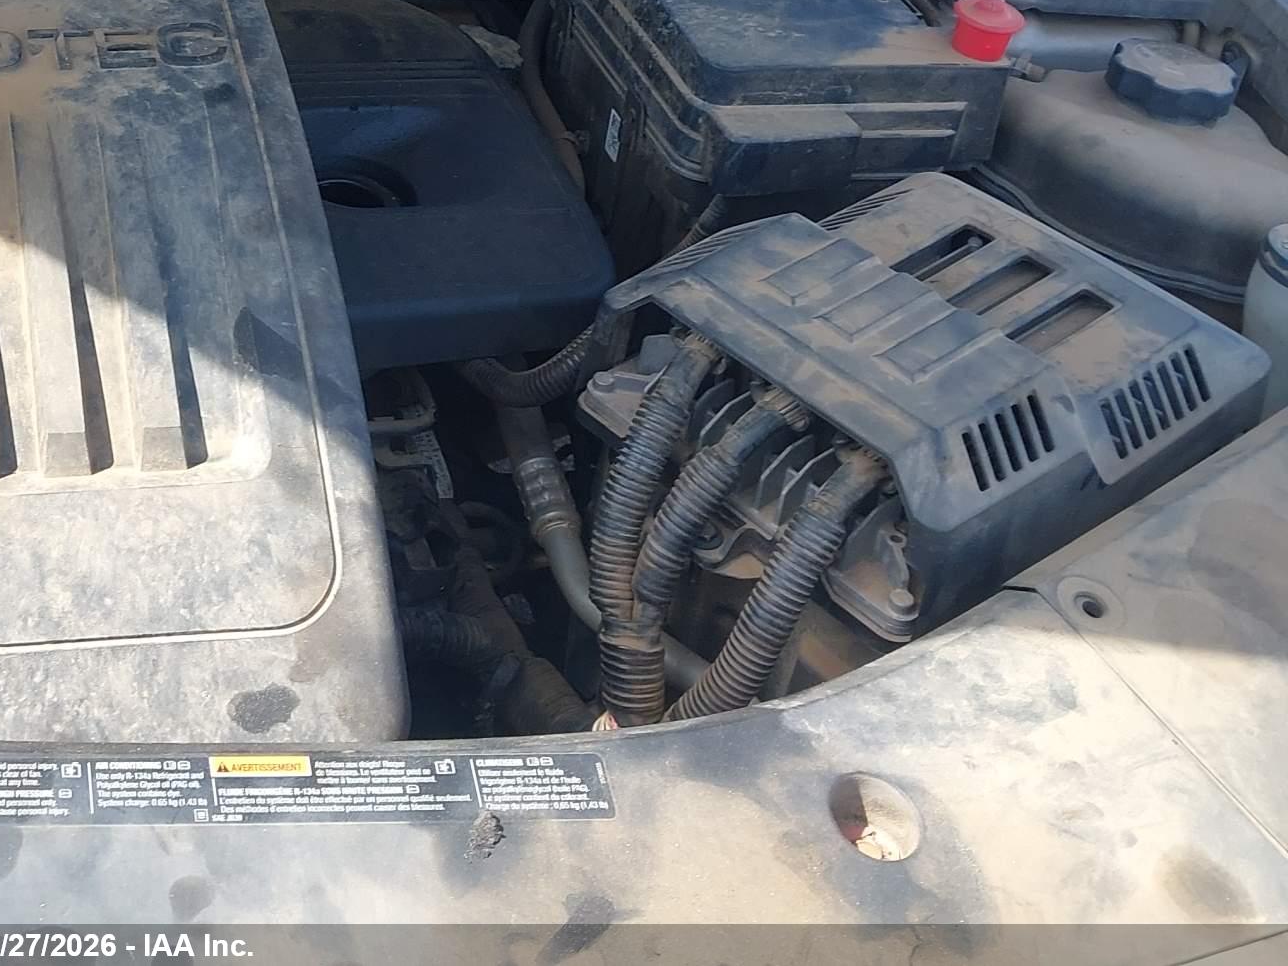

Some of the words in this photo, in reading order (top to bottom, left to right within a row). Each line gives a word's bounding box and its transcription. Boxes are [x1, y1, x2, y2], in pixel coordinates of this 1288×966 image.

[7, 763, 37, 771] personal
[109, 761, 162, 769] CONDITIONING
[232, 763, 302, 772] AVERTISSEMENT
[110, 772, 124, 780] only
[152, 772, 190, 780] Refrigerant
[191, 771, 204, 779] and
[112, 790, 136, 798] system
[98, 799, 124, 807] System
[168, 798, 178, 807] kg
[17, 808, 48, 816] personal
